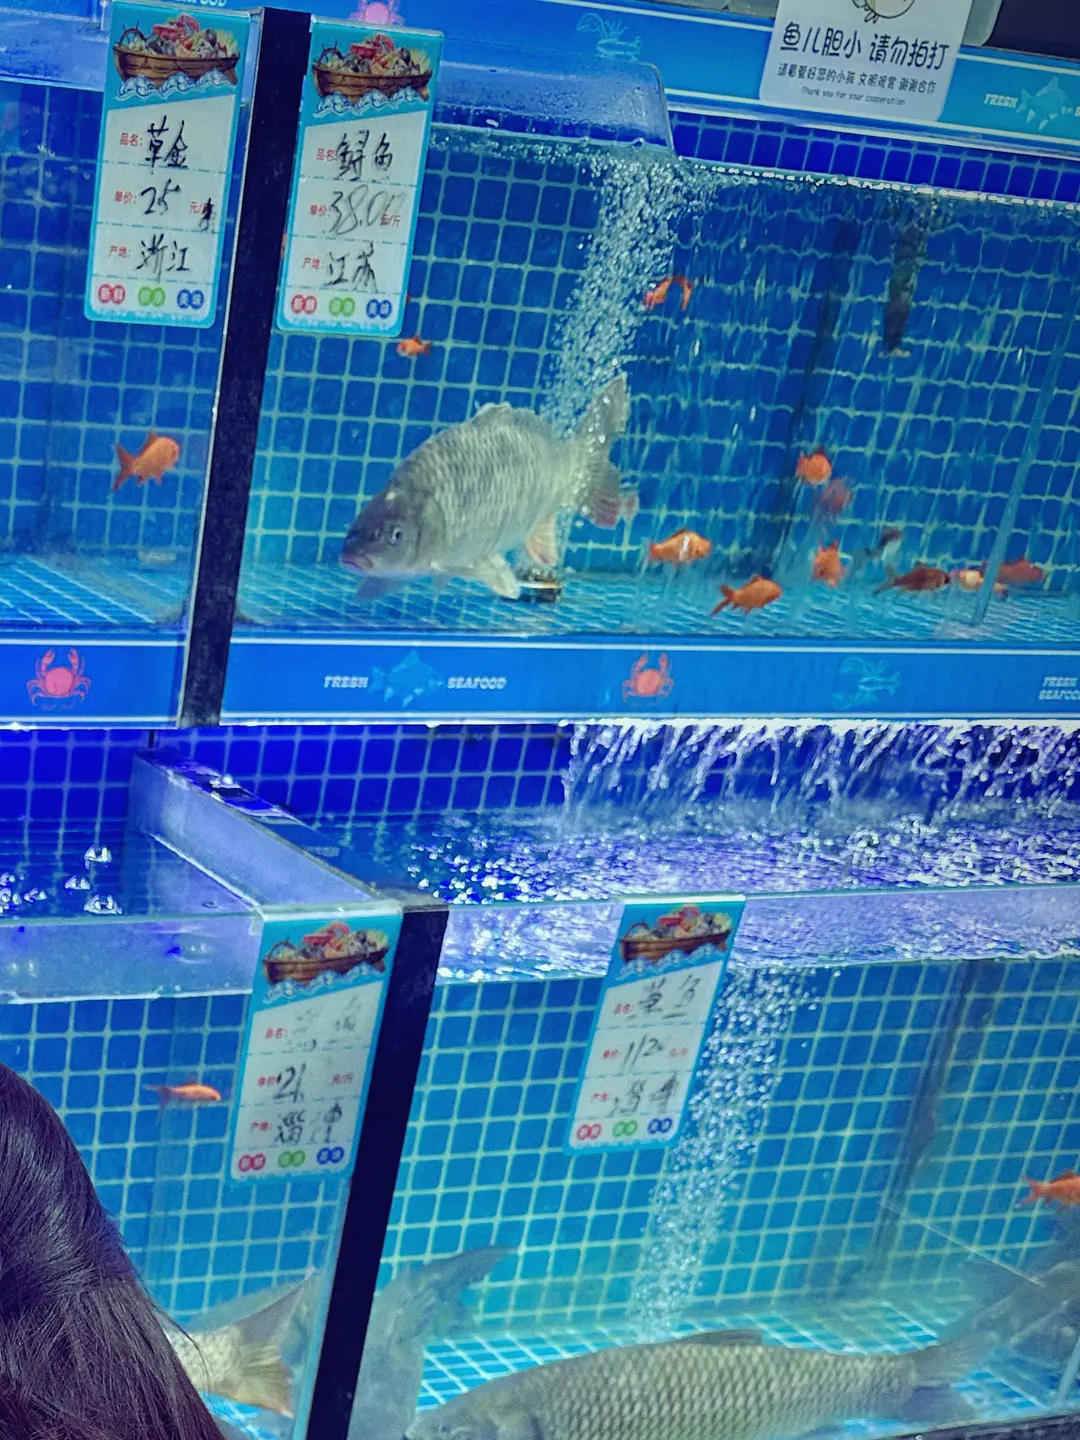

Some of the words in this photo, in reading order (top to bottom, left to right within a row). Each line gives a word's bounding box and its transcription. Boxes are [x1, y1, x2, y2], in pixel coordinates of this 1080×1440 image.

[780, 21, 862, 59] 鱼儿胆小
[869, 33, 950, 71] 请勿拍打
[984, 93, 1018, 108] FRESH
[136, 233, 190, 283] 浙江
[324, 675, 369, 688] FRESH
[447, 676, 507, 689] SEAFOOD
[1042, 676, 1078, 687] FRESH
